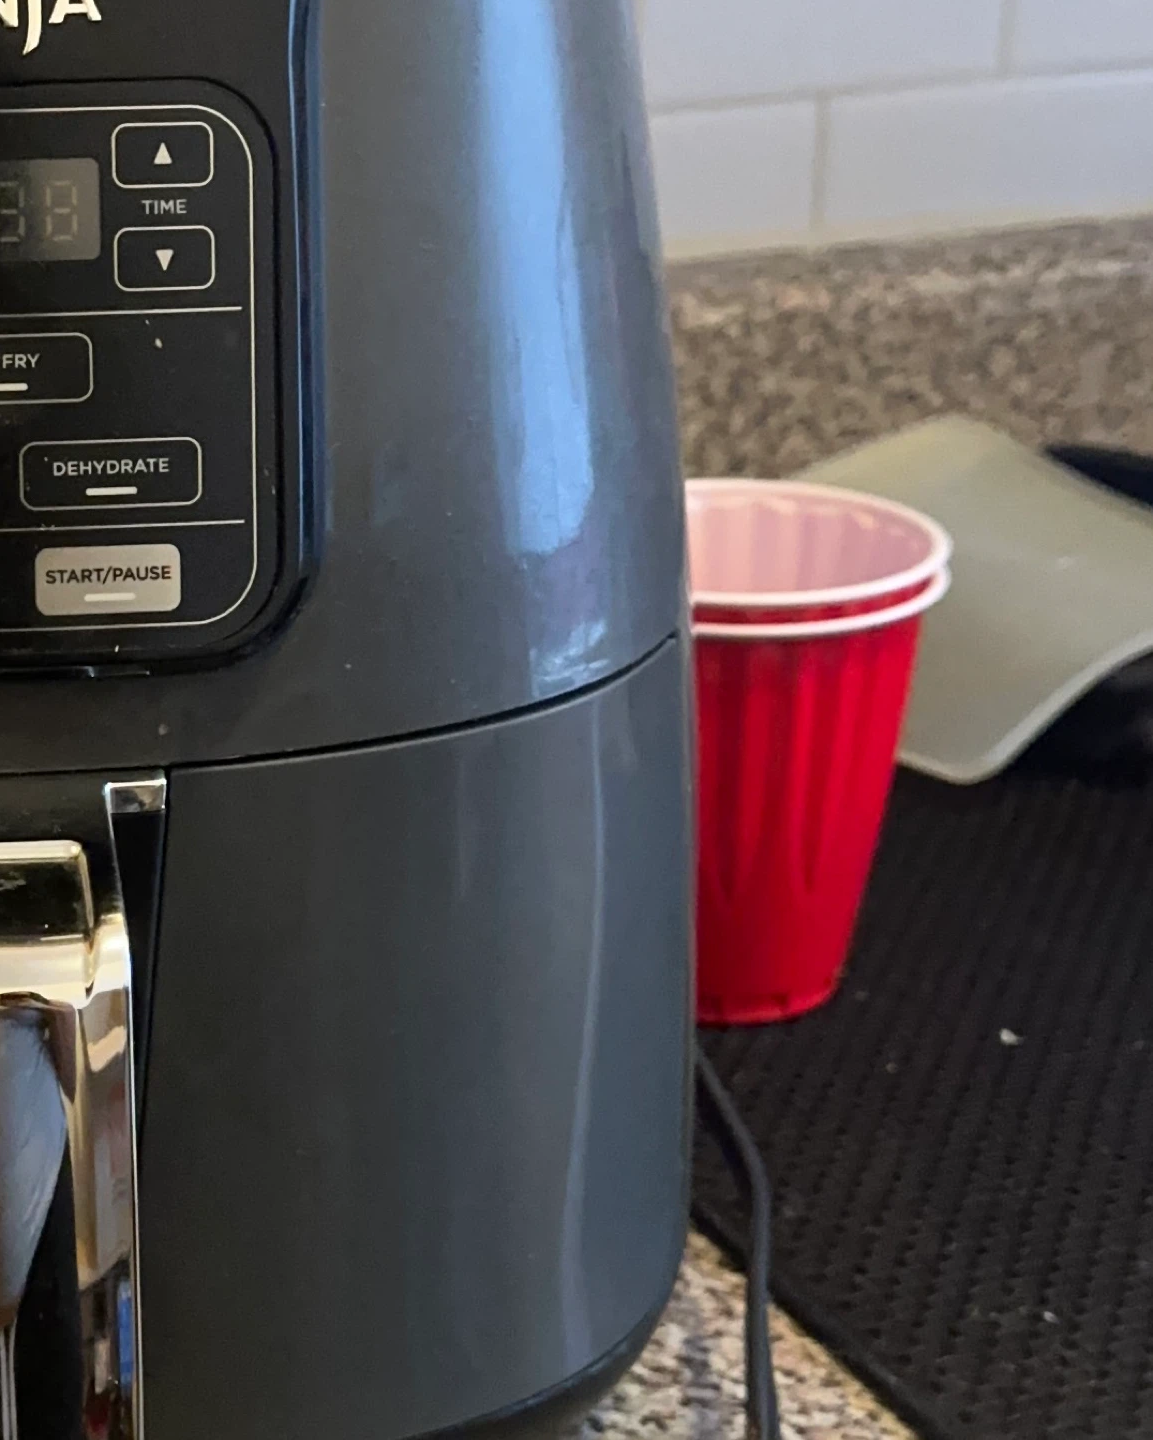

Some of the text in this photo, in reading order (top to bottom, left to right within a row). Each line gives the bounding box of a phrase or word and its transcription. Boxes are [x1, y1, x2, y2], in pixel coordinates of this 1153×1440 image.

[141, 199, 187, 216] TIME
[2, 353, 40, 369] FRY
[52, 458, 170, 477] DEHYDRATE
[45, 565, 172, 584] START/PAUSE
